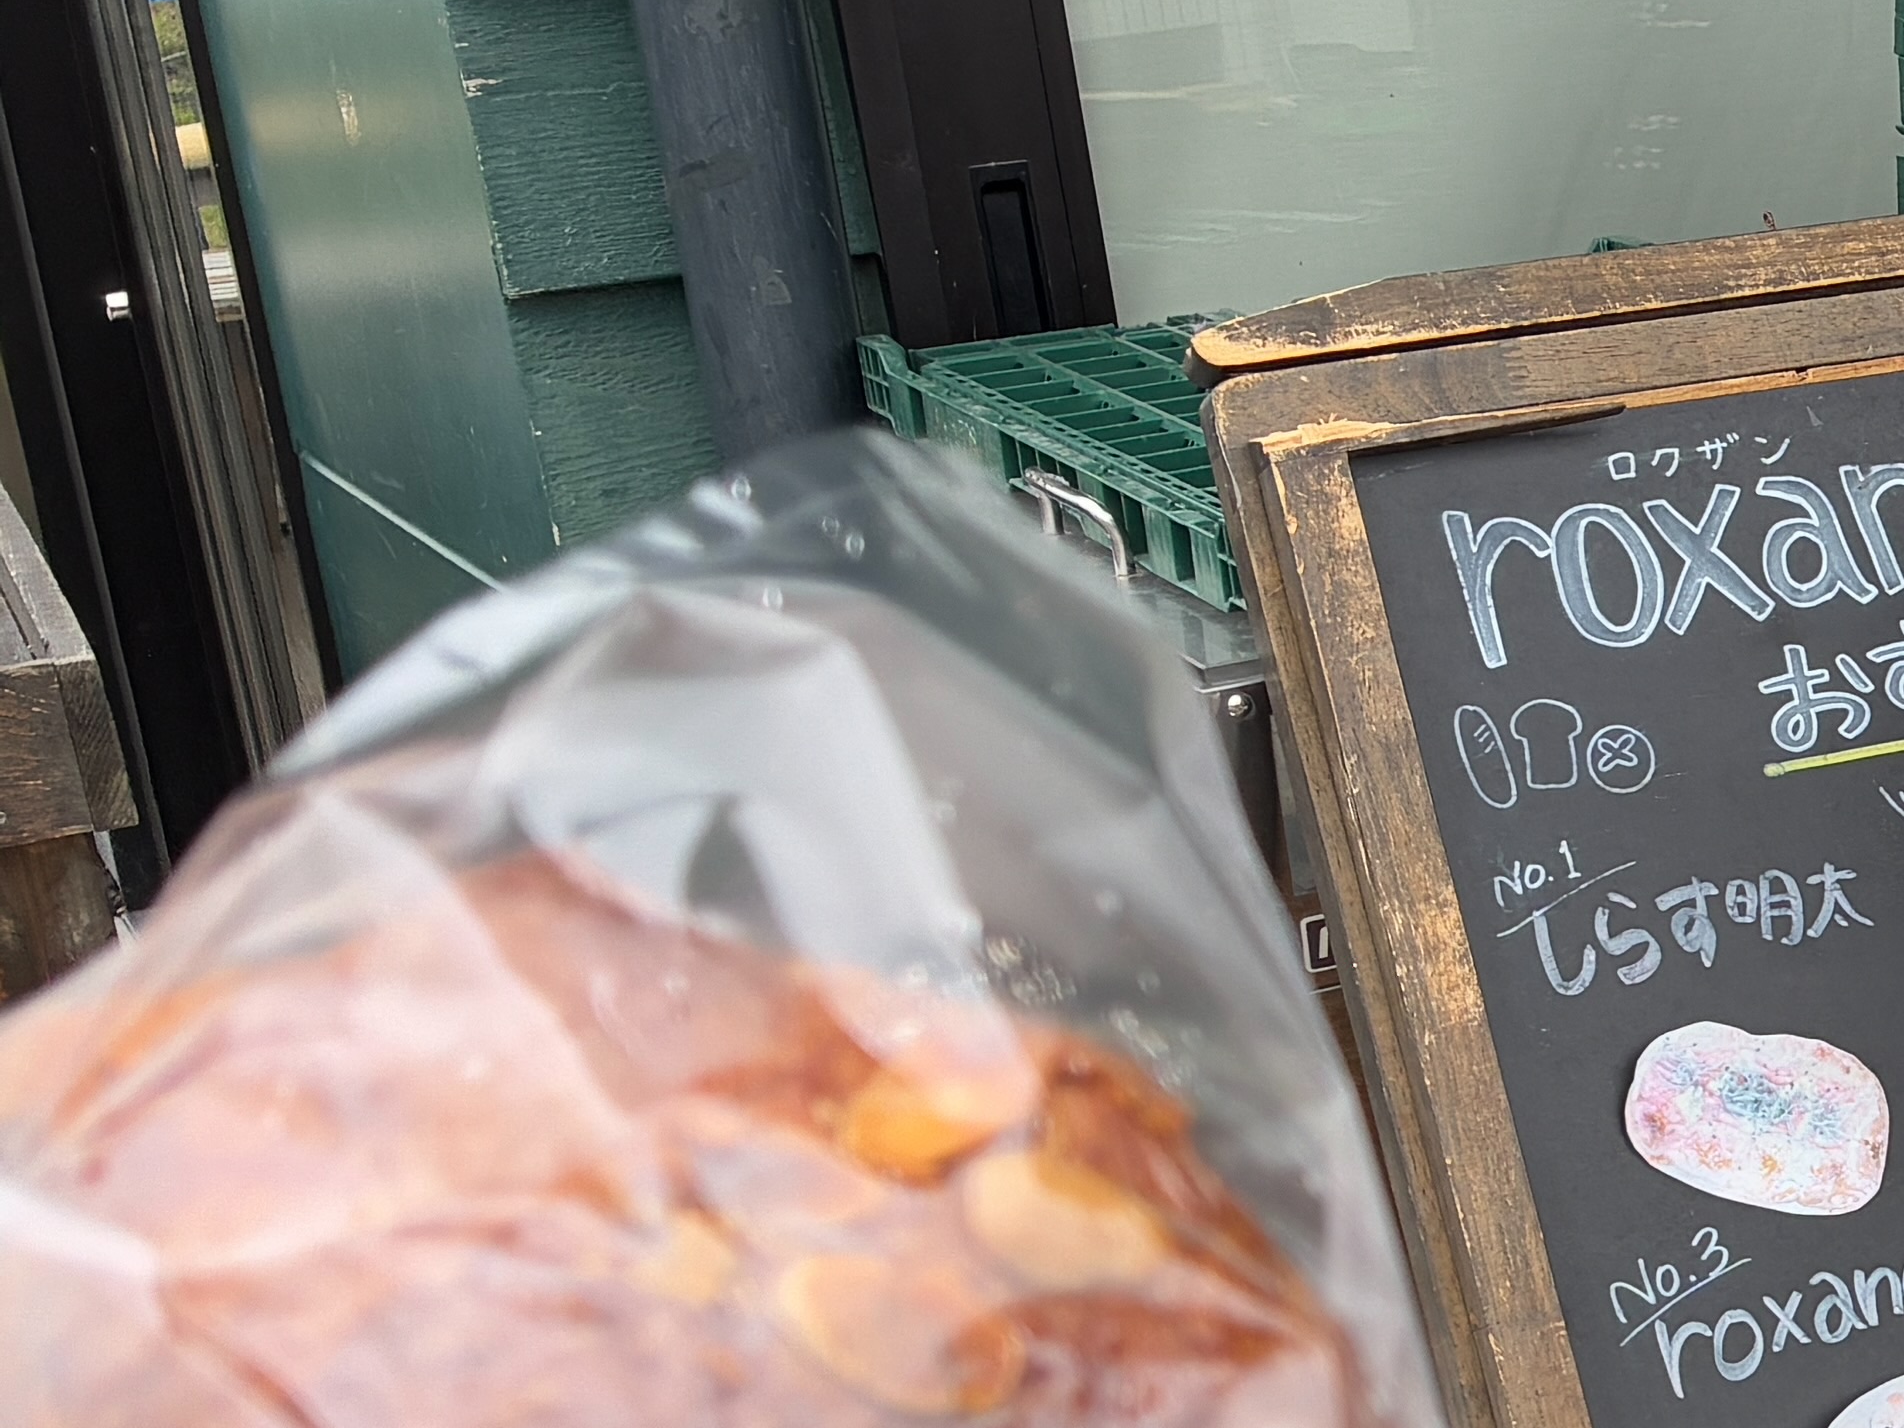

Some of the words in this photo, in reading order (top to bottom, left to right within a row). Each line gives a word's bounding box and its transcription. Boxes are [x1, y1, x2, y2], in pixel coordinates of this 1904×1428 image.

[1605, 432, 1793, 484] ロクザン
[1493, 838, 1584, 910] No.1
[1531, 860, 1875, 999] しらす明太
[1606, 1225, 1735, 1328] No.3
